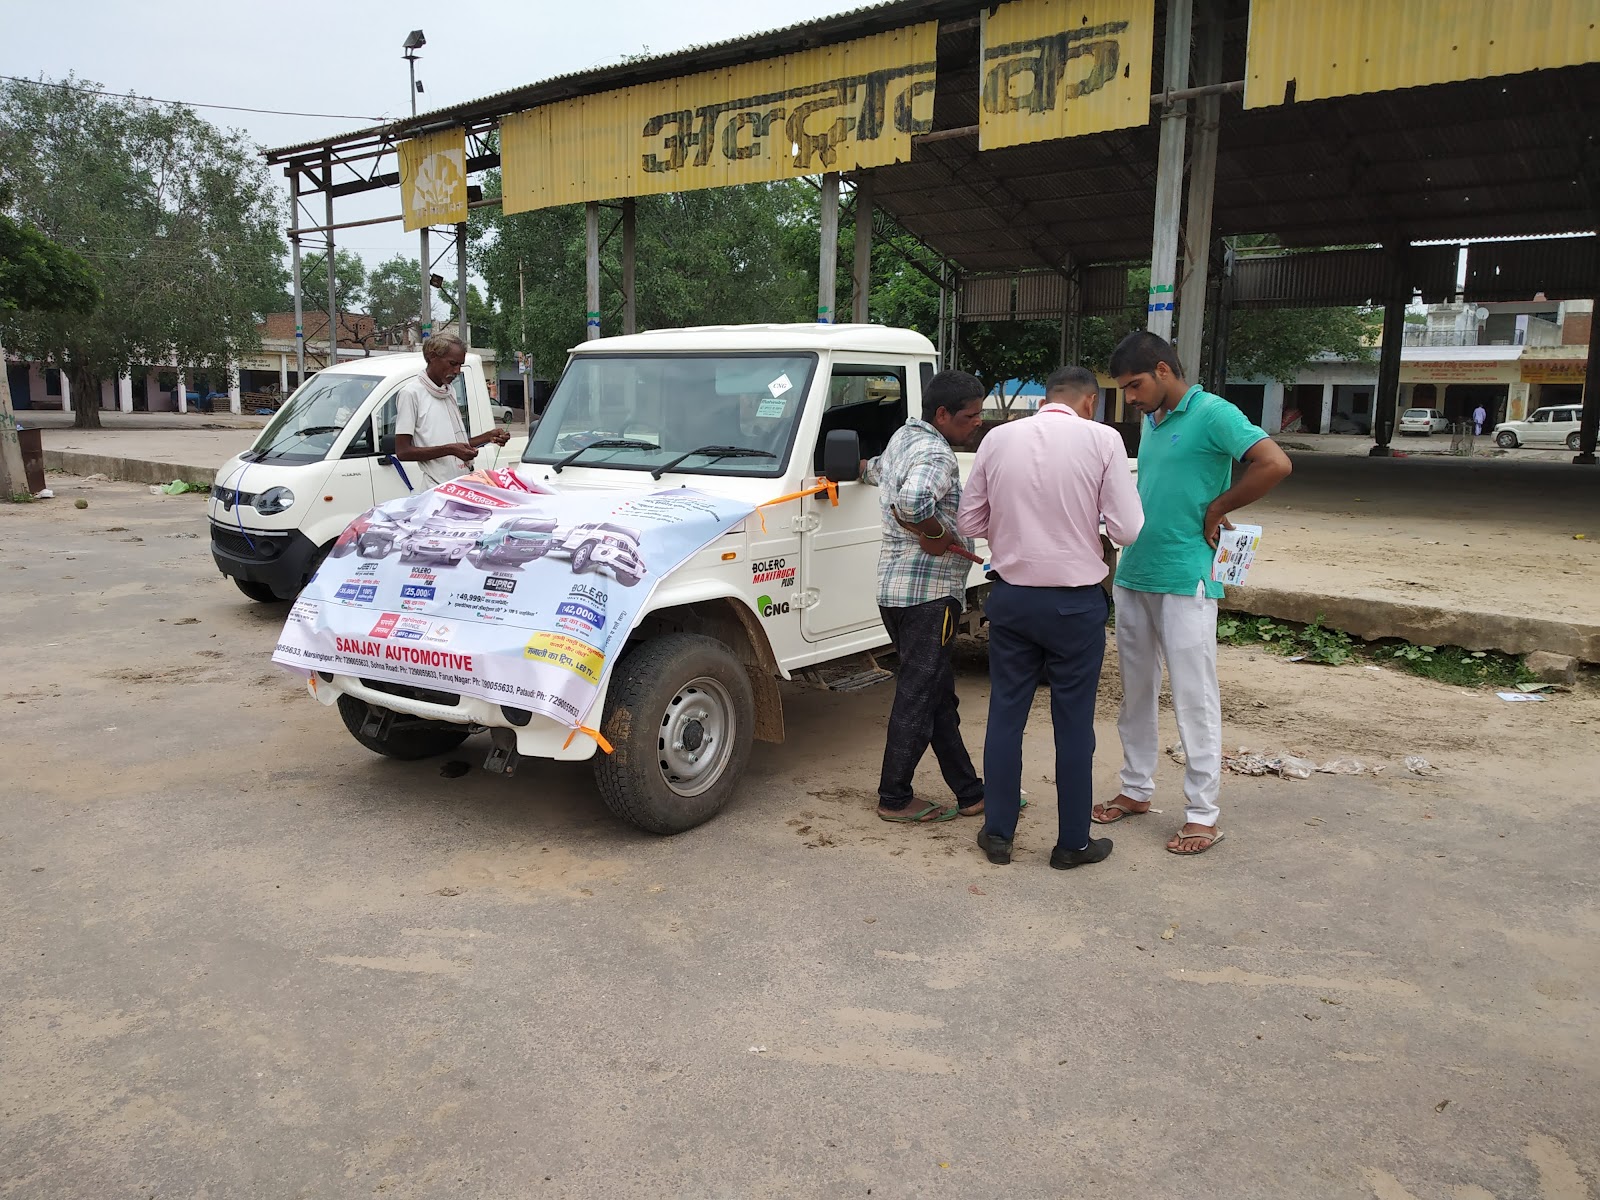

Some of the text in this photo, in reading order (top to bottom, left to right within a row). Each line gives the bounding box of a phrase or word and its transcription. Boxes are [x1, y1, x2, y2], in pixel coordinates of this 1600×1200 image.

[752, 558, 785, 573] BOLERO
[486, 578, 514, 589] SUPRO
[752, 567, 796, 584] MAXITRUCK
[781, 577, 794, 587] PLUS
[571, 584, 608, 603] BOLERO
[764, 602, 790, 617] CNG
[336, 637, 473, 671] SANJAY AUTOMOTIVE
[528, 646, 547, 658] मनाली
[548, 651, 558, 661] का
[576, 662, 586, 672] LED
[587, 668, 593, 677] TV
[303, 650, 334, 662] Narsinghpur:
[343, 657, 370, 668] 7290055633,
[370, 661, 385, 669] Sohna
[386, 663, 399, 672] Road:
[408, 667, 438, 680] 7290055633,
[439, 672, 454, 683] Faruq
[454, 675, 472, 685] Nagar:
[516, 687, 535, 699] Pataudi:
[536, 691, 547, 700] Ph:
[549, 695, 580, 717] 7290055633
